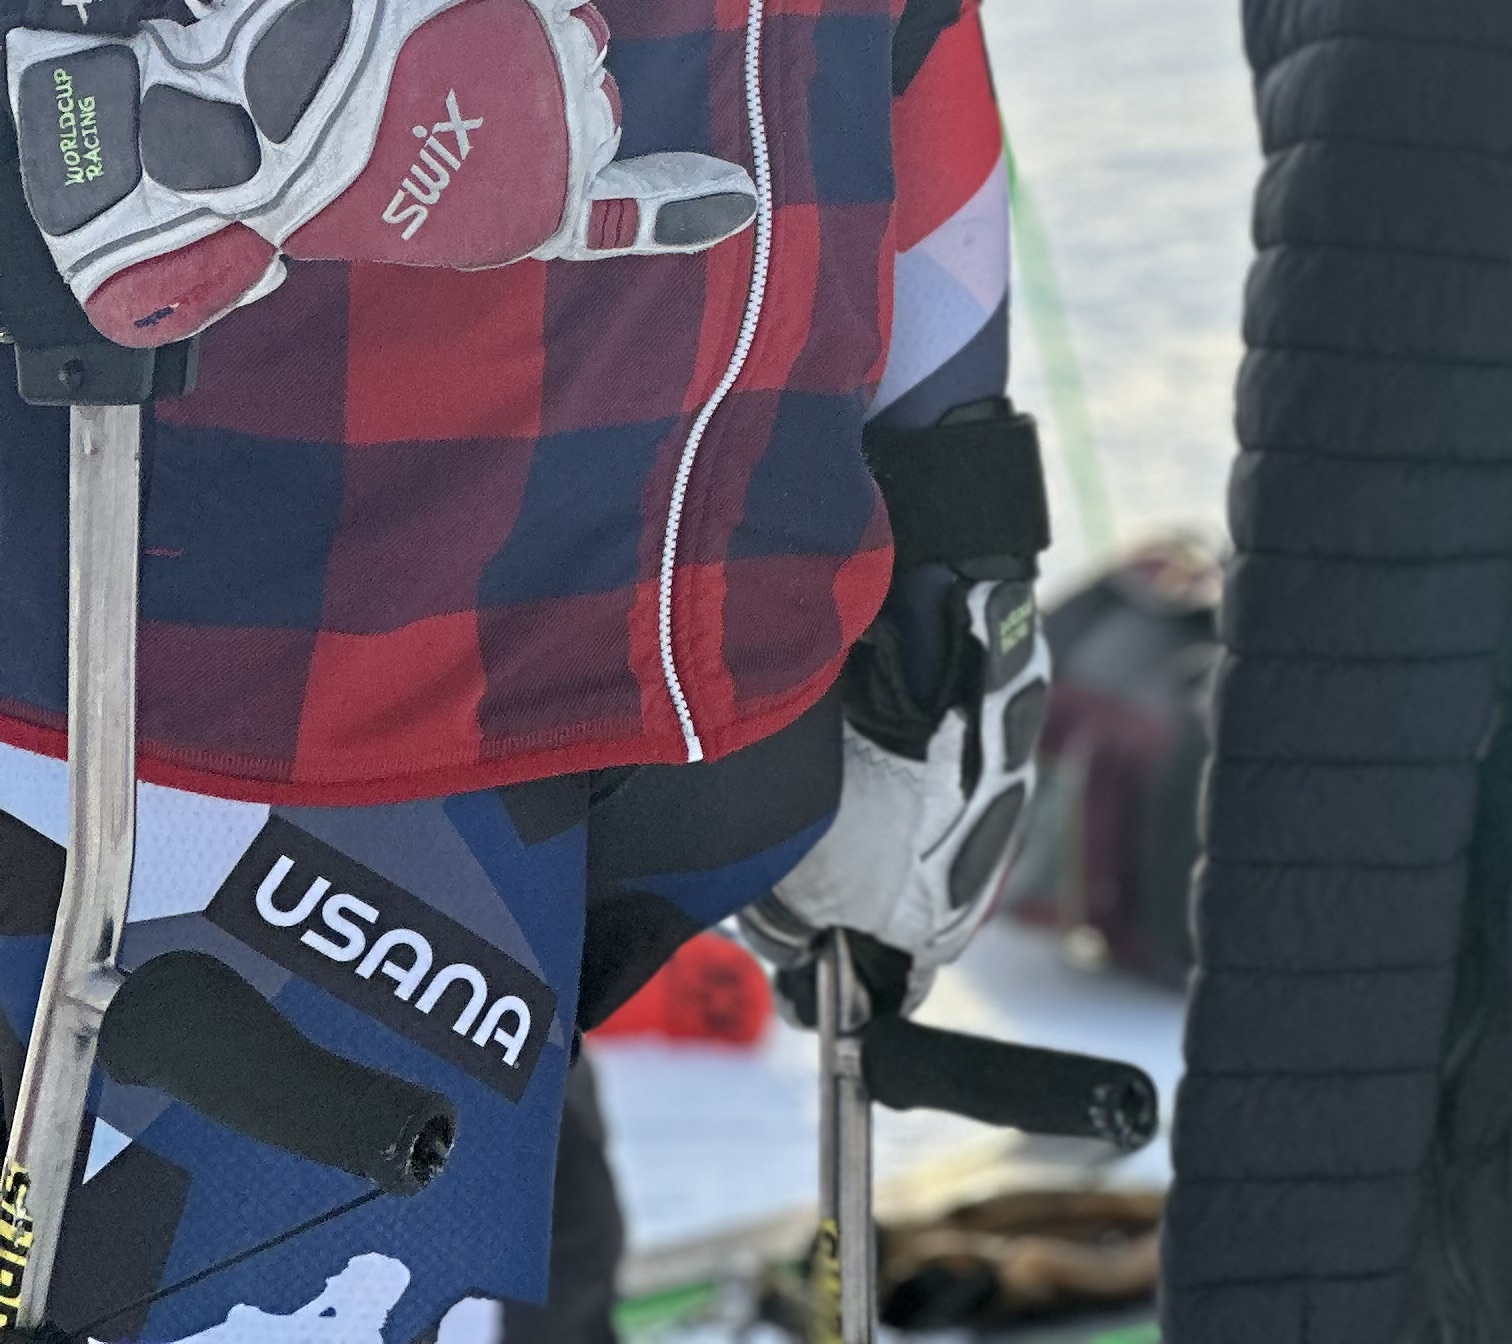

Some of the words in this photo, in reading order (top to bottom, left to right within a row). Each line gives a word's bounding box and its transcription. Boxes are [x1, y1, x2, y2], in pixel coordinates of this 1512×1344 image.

[53, 67, 85, 187] WORLDCUP
[78, 95, 105, 182] RACING
[255, 853, 531, 1068] USANA
